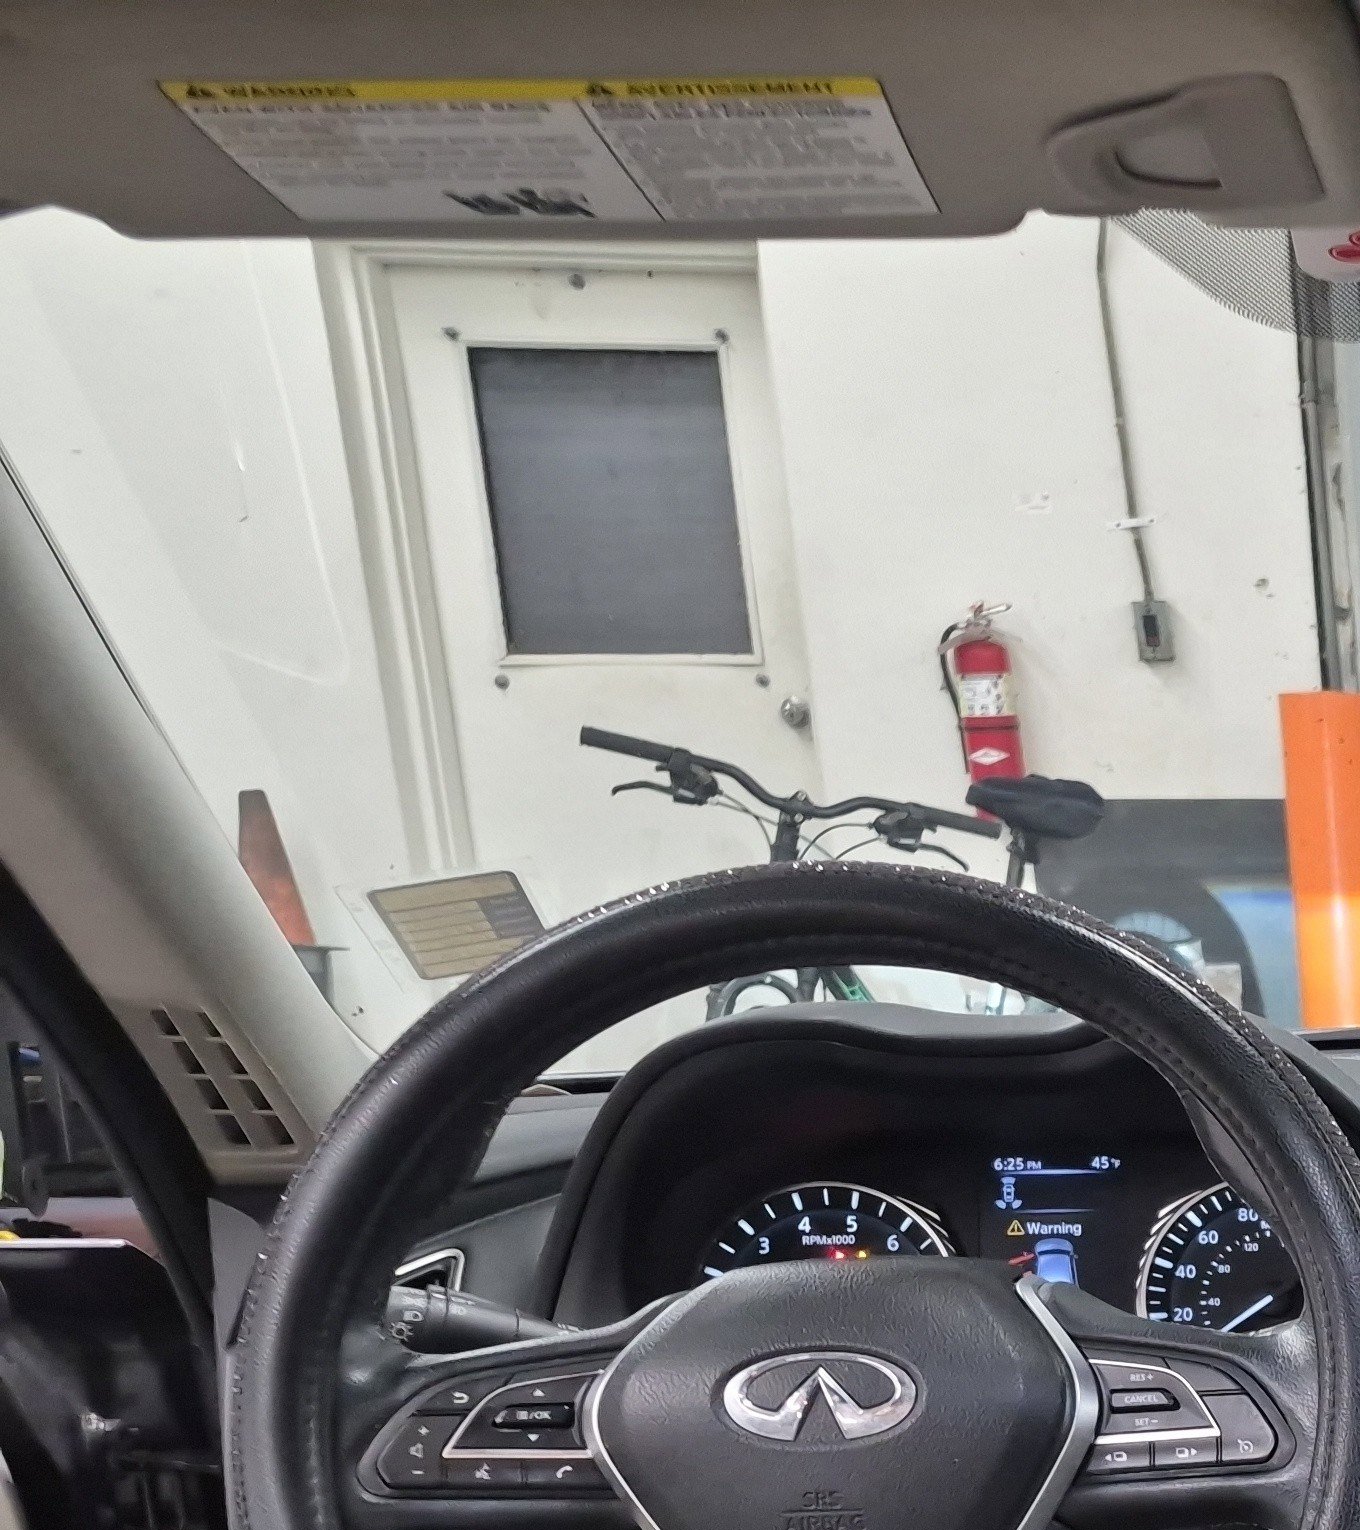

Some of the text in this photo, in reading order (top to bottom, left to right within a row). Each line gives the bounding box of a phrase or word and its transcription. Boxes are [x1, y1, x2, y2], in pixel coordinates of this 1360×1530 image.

[993, 1157, 1042, 1171] 6:25 PM
[1090, 1155, 1110, 1169] 45
[1237, 1207, 1259, 1222] 80
[797, 1216, 812, 1233] 4
[846, 1216, 858, 1233] 5
[1026, 1221, 1082, 1237] Warning
[801, 1235, 856, 1246] RPMx1000
[886, 1235, 900, 1252] 6
[1198, 1230, 1219, 1244] 60
[758, 1238, 770, 1255] 3
[1243, 1242, 1259, 1252] 120
[1174, 1264, 1197, 1279] 40
[1217, 1265, 1231, 1274] 80
[1207, 1297, 1221, 1306] 40
[1173, 1307, 1193, 1322] 20
[1124, 1394, 1158, 1404] CANCEL
